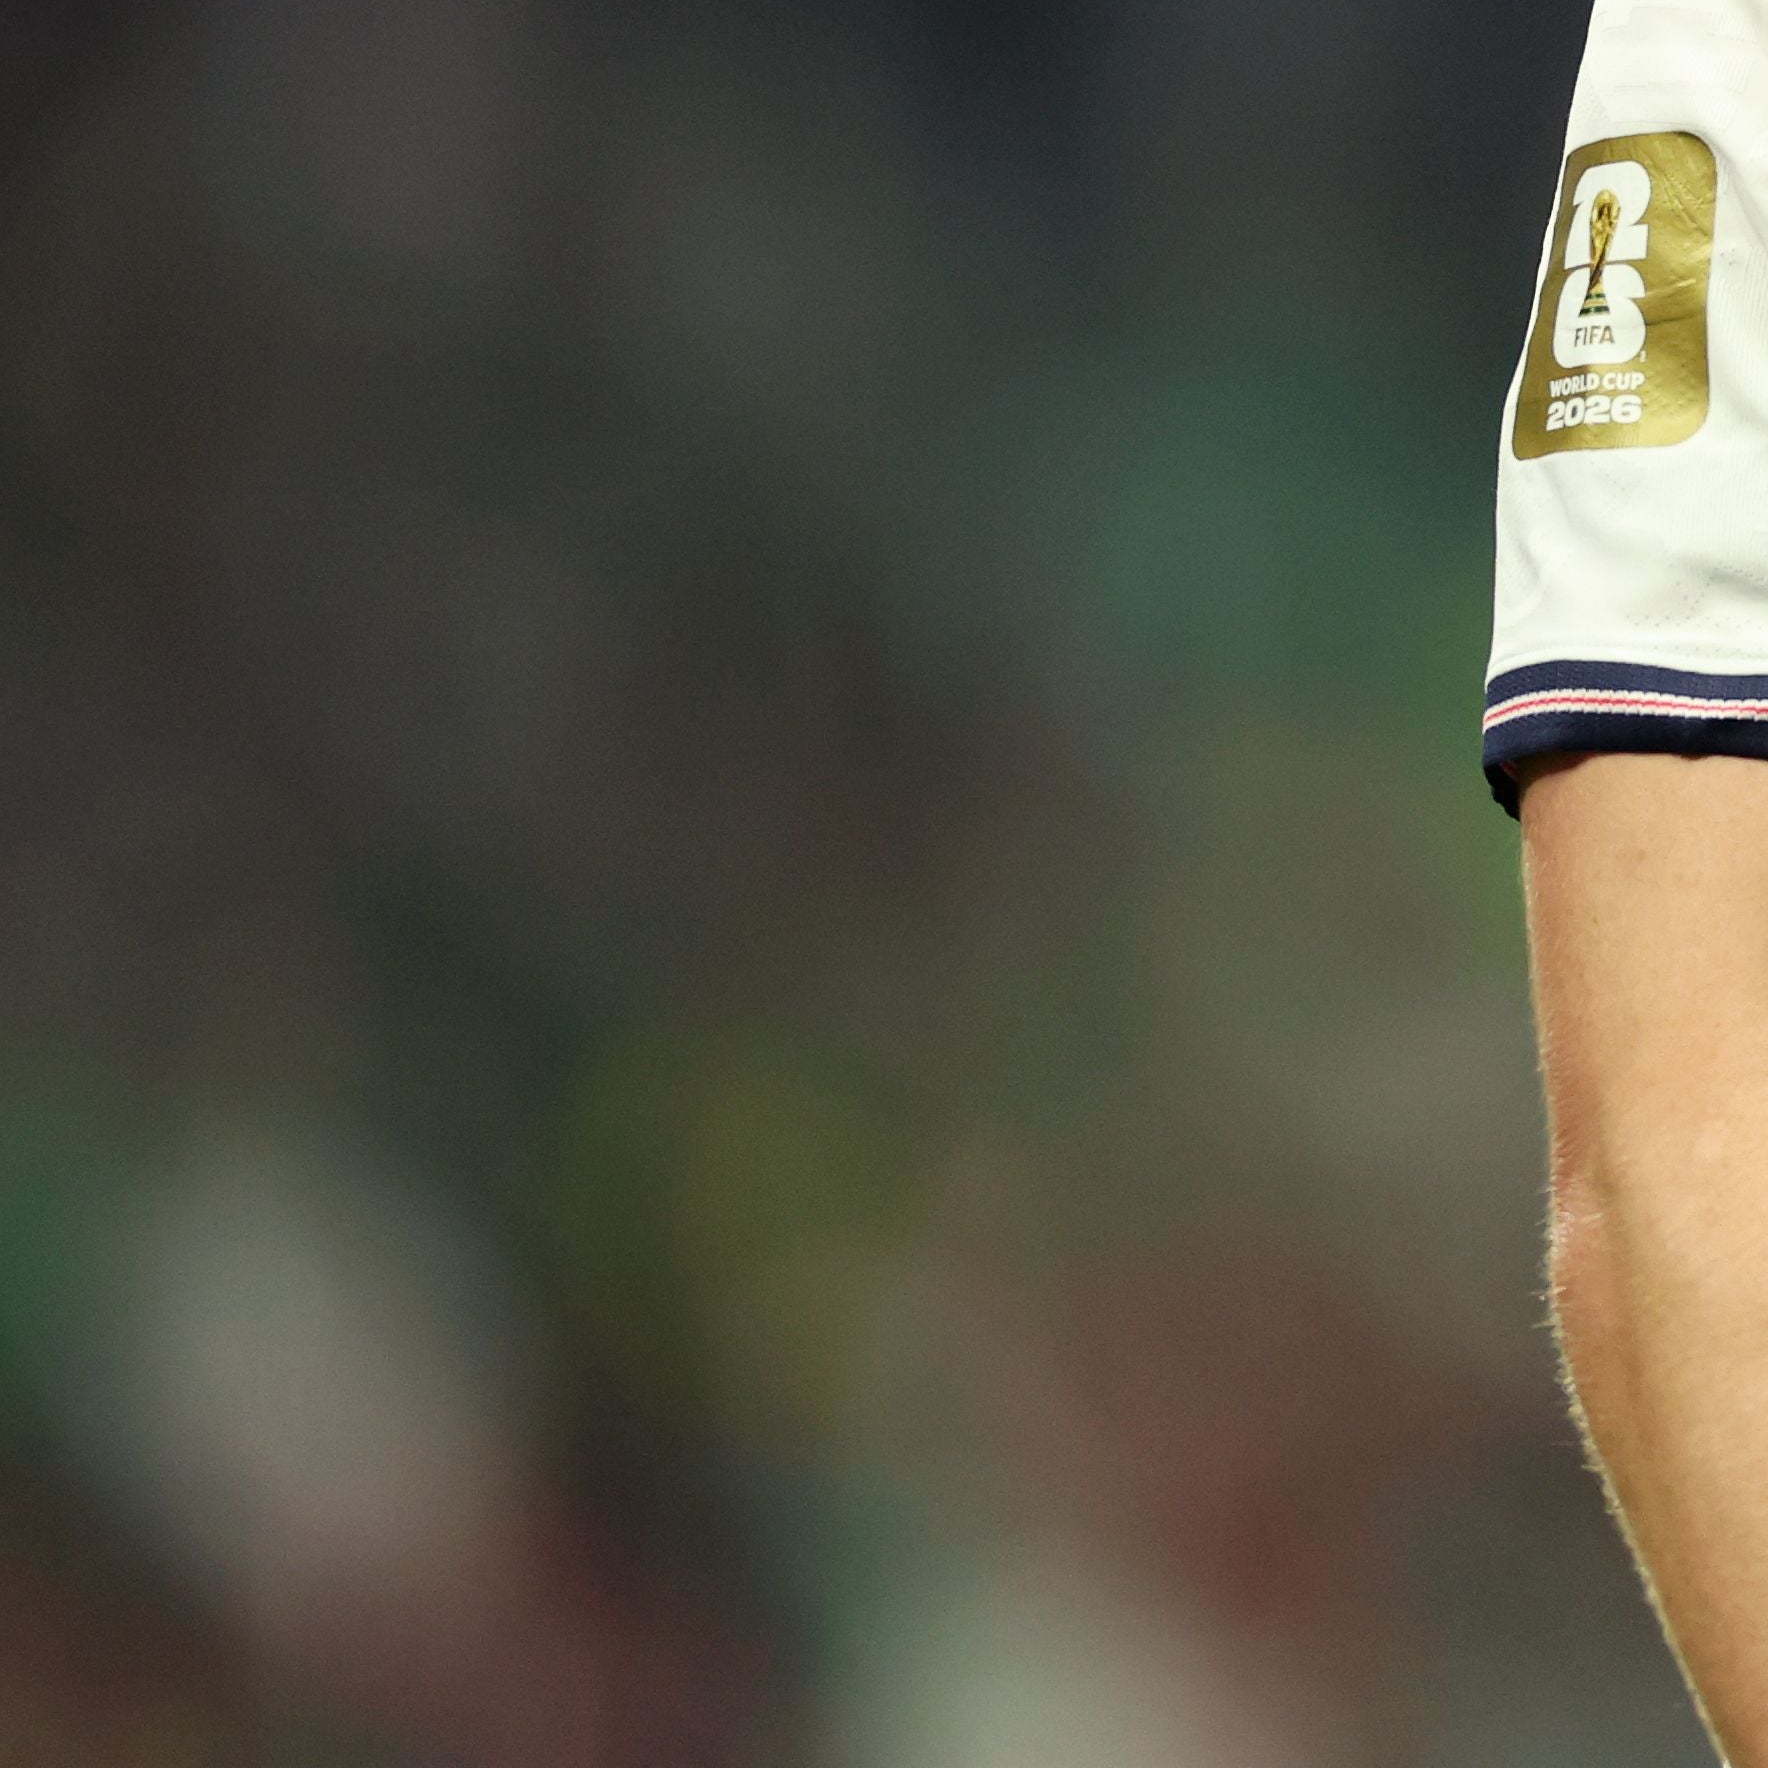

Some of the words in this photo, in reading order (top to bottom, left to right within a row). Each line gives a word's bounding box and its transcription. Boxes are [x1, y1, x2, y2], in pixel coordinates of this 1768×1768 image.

[1573, 325, 1615, 347] FIFA
[1550, 373, 1600, 398] WORLD
[1602, 371, 1646, 391] CUP
[1546, 394, 1643, 431] 2026
